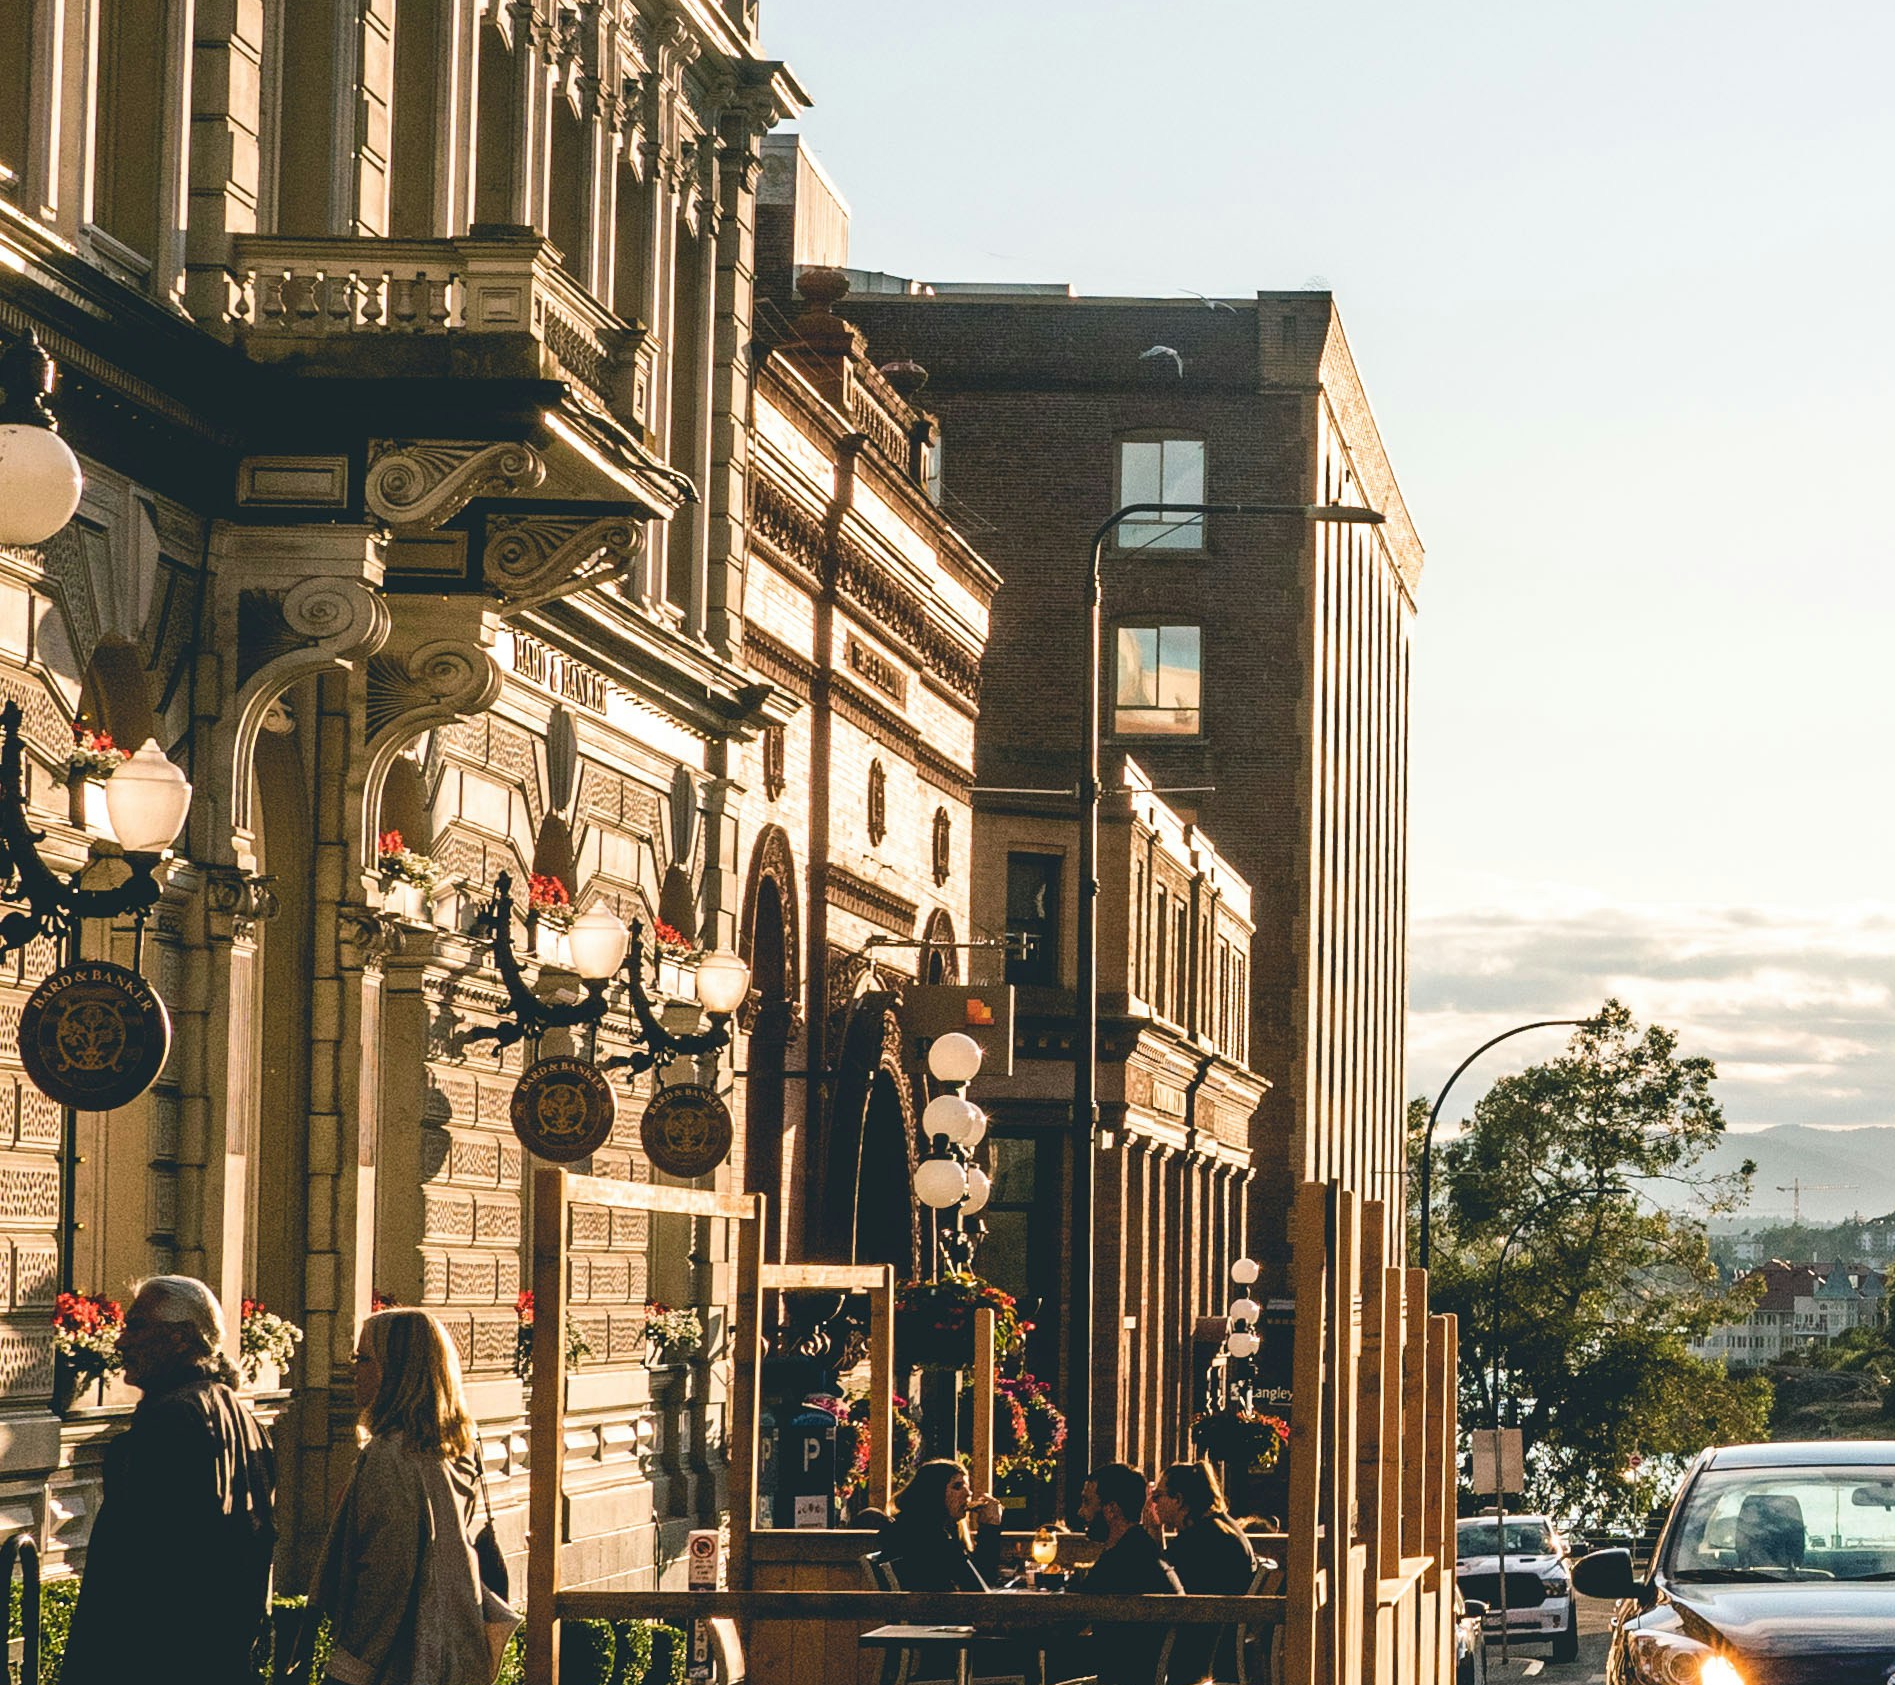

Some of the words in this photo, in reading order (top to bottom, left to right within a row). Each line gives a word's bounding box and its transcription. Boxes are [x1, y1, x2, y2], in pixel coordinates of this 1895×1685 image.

[512, 631, 546, 685] BARD
[32, 974, 73, 1010] BARD
[75, 971, 88, 982] &
[92, 969, 154, 1012] BANKER
[519, 1066, 547, 1093] BARD
[561, 1061, 606, 1092] BANKER
[804, 1437, 820, 1473] P
